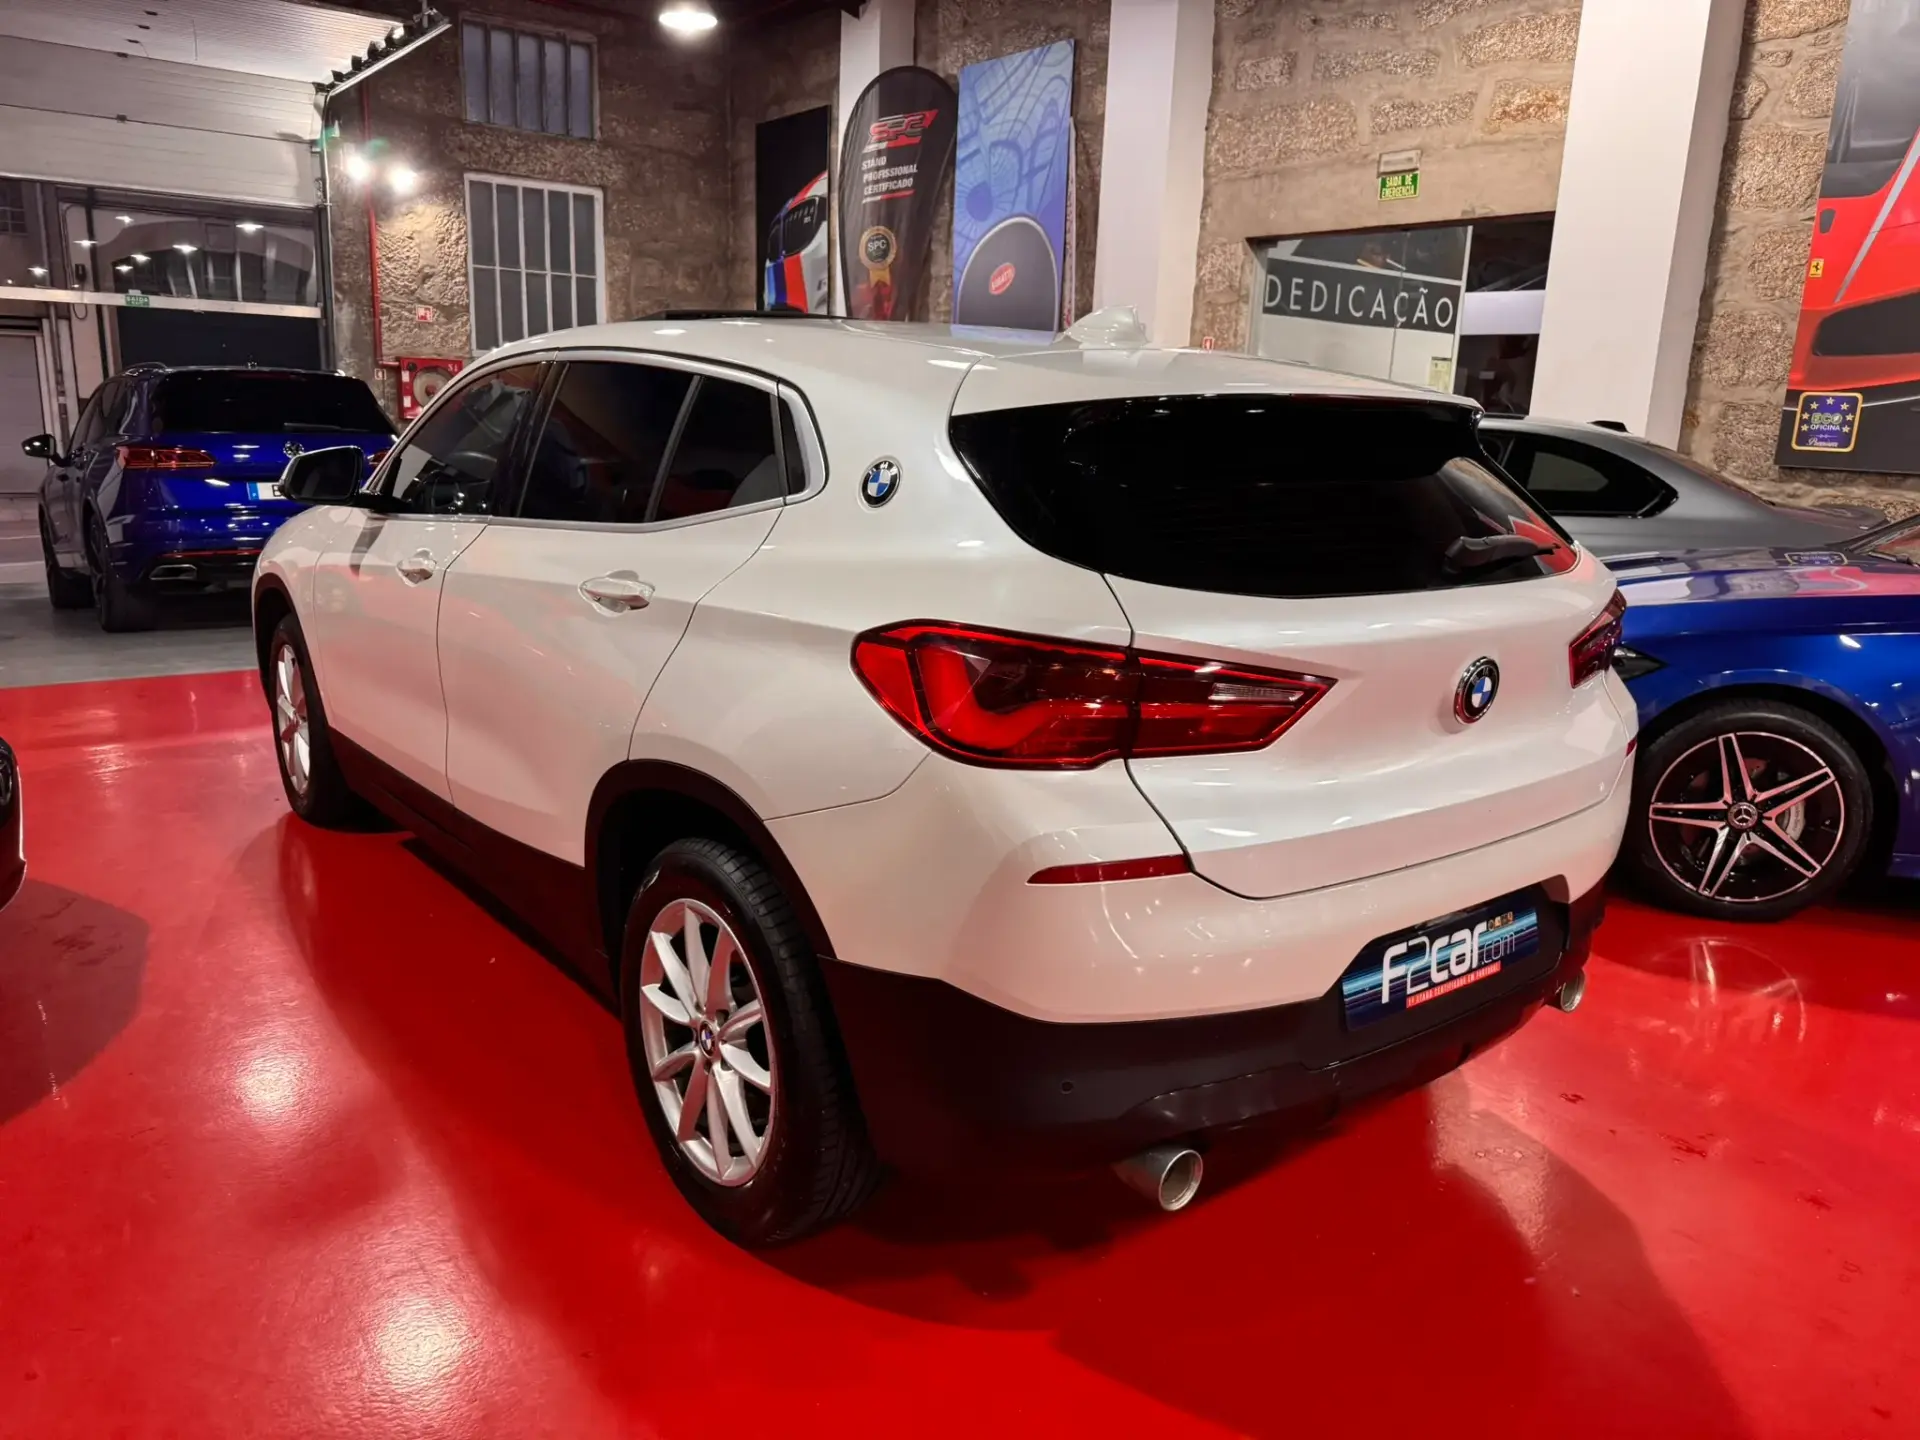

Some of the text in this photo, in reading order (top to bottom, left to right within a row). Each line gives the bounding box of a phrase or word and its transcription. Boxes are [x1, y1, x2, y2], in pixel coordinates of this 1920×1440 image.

[862, 156, 887, 171] STAND
[863, 164, 918, 183] PROFISSIONAL
[1405, 173, 1412, 185] DE
[864, 178, 914, 196] CERTIFICADO
[868, 240, 887, 252] SPC
[1264, 274, 1454, 328] DEDICAÇÃO
[1811, 412, 1843, 425] ECO
